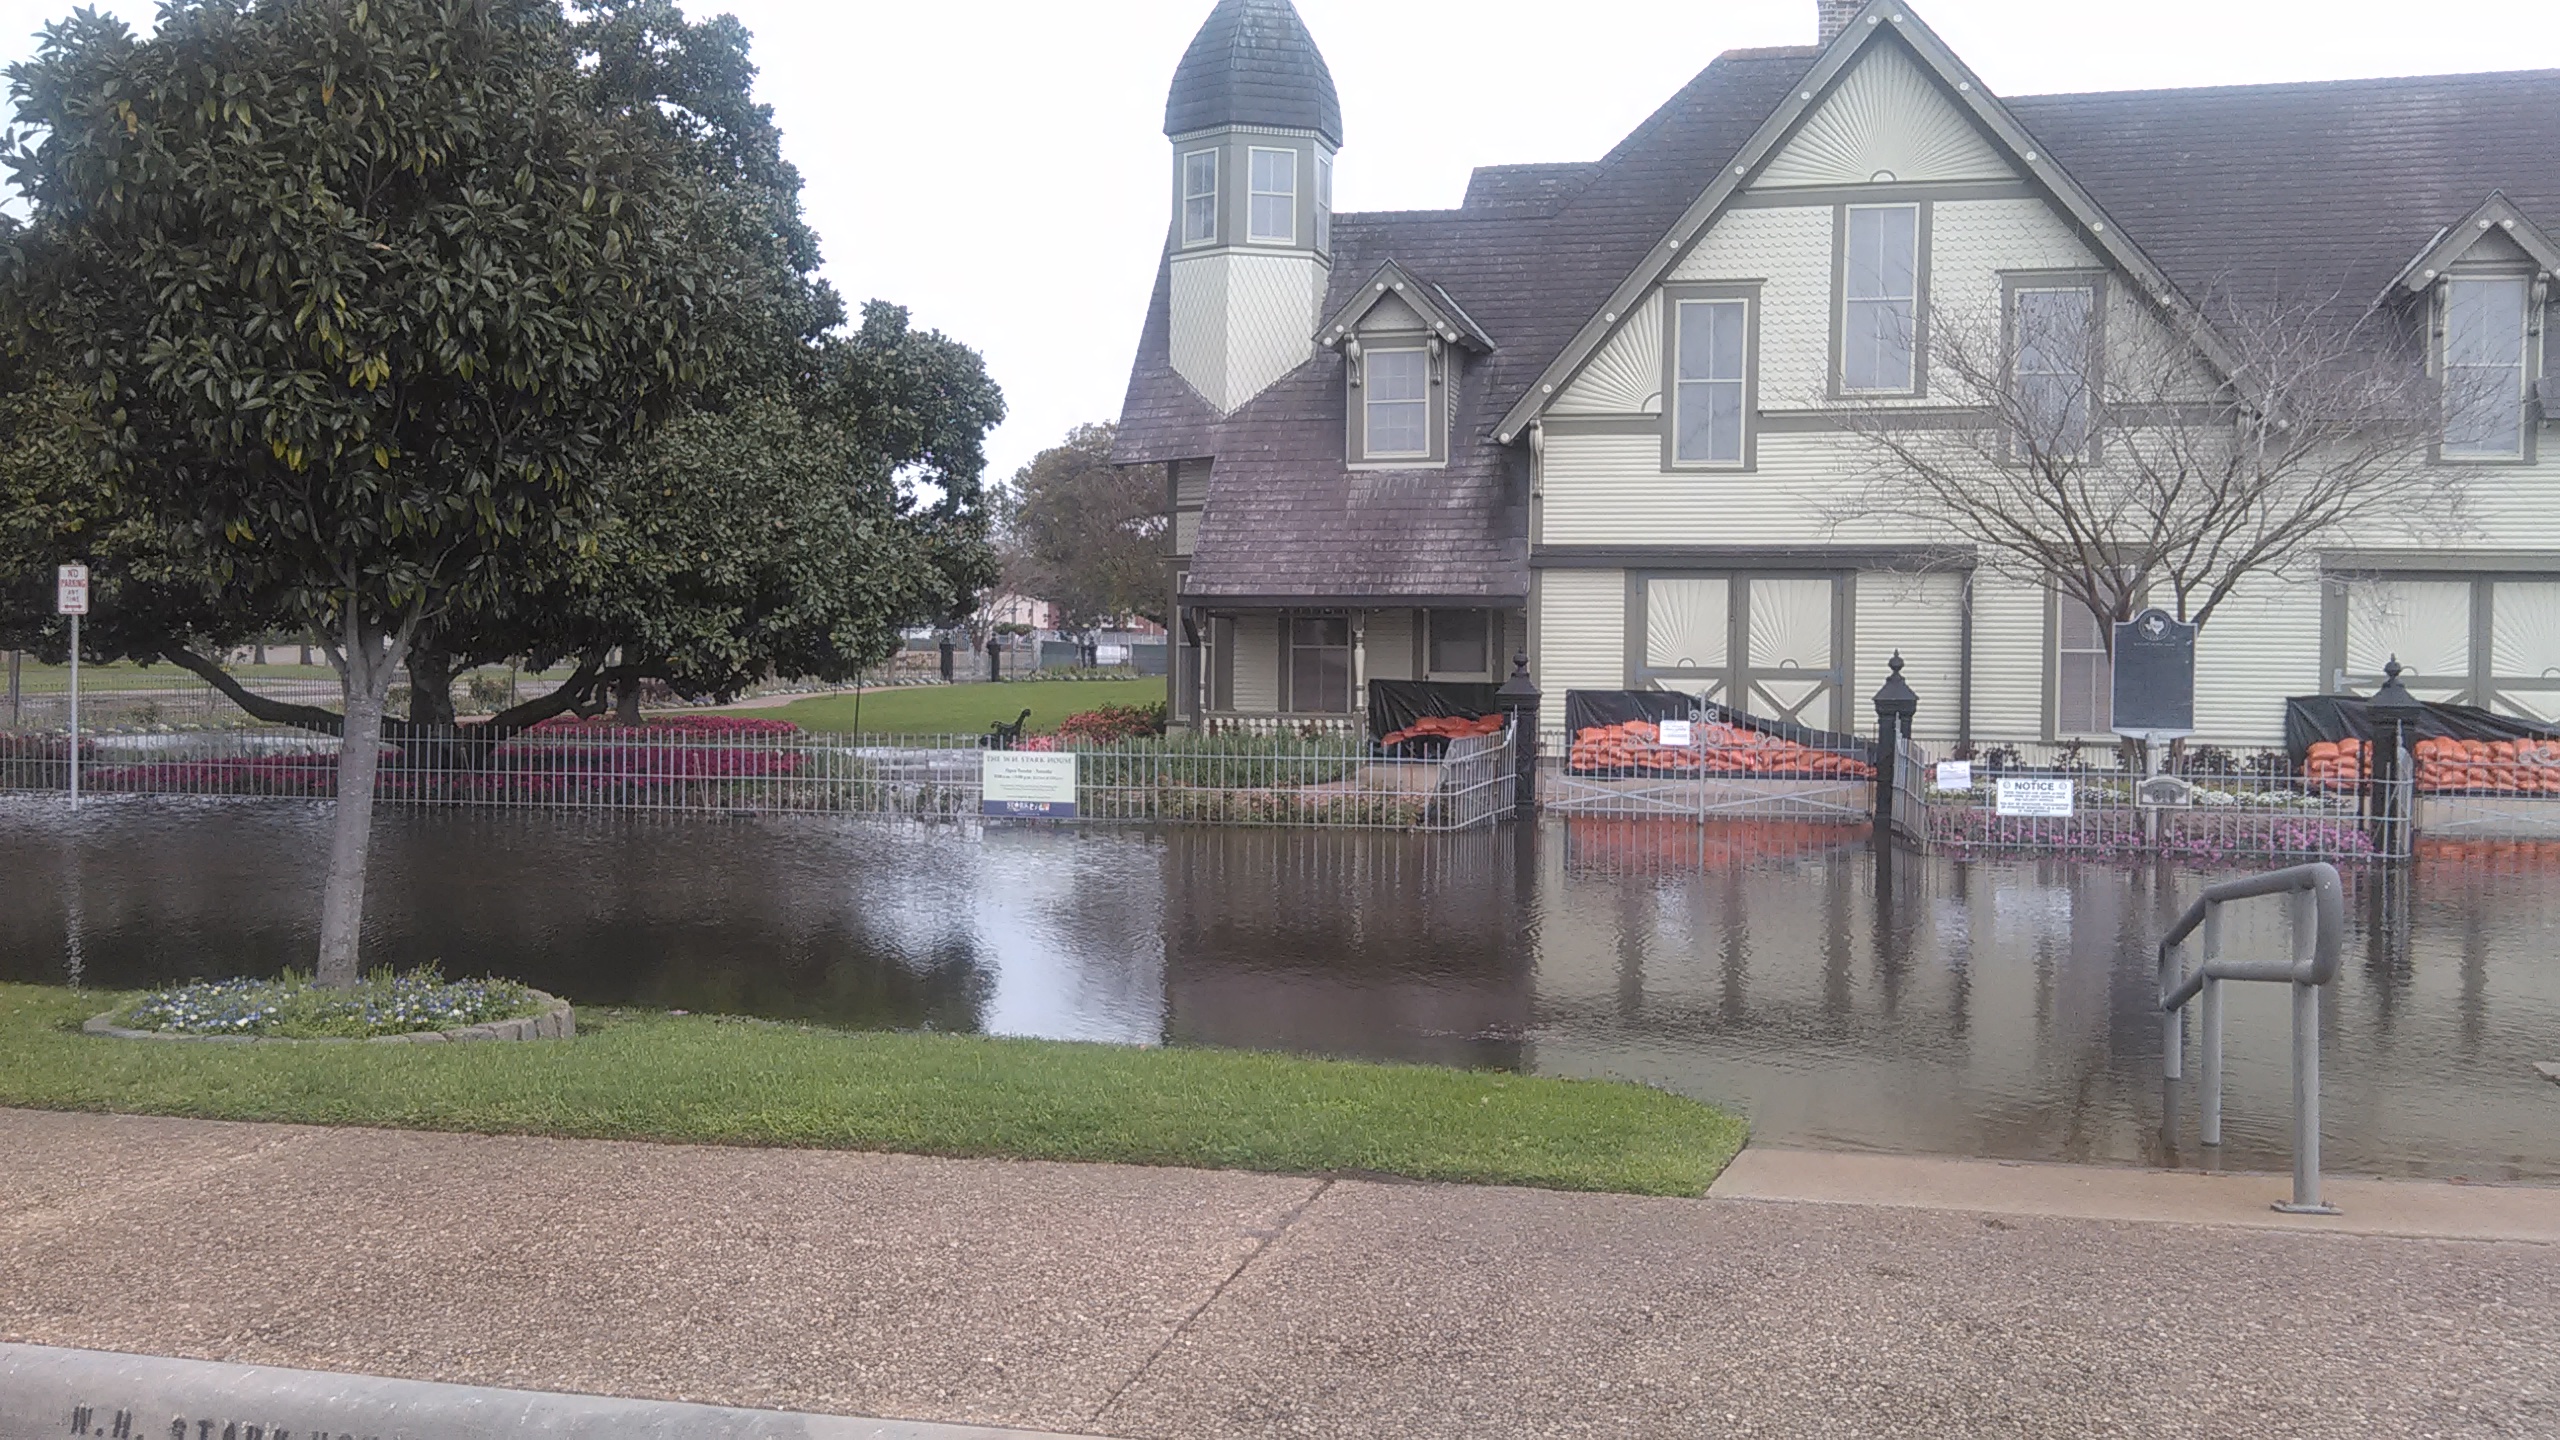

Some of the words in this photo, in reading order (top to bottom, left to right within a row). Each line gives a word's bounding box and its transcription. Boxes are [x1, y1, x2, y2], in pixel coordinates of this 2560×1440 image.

[67, 569, 79, 578] NO
[61, 579, 86, 587] PARKING
[2014, 781, 2055, 791] NOTICE
